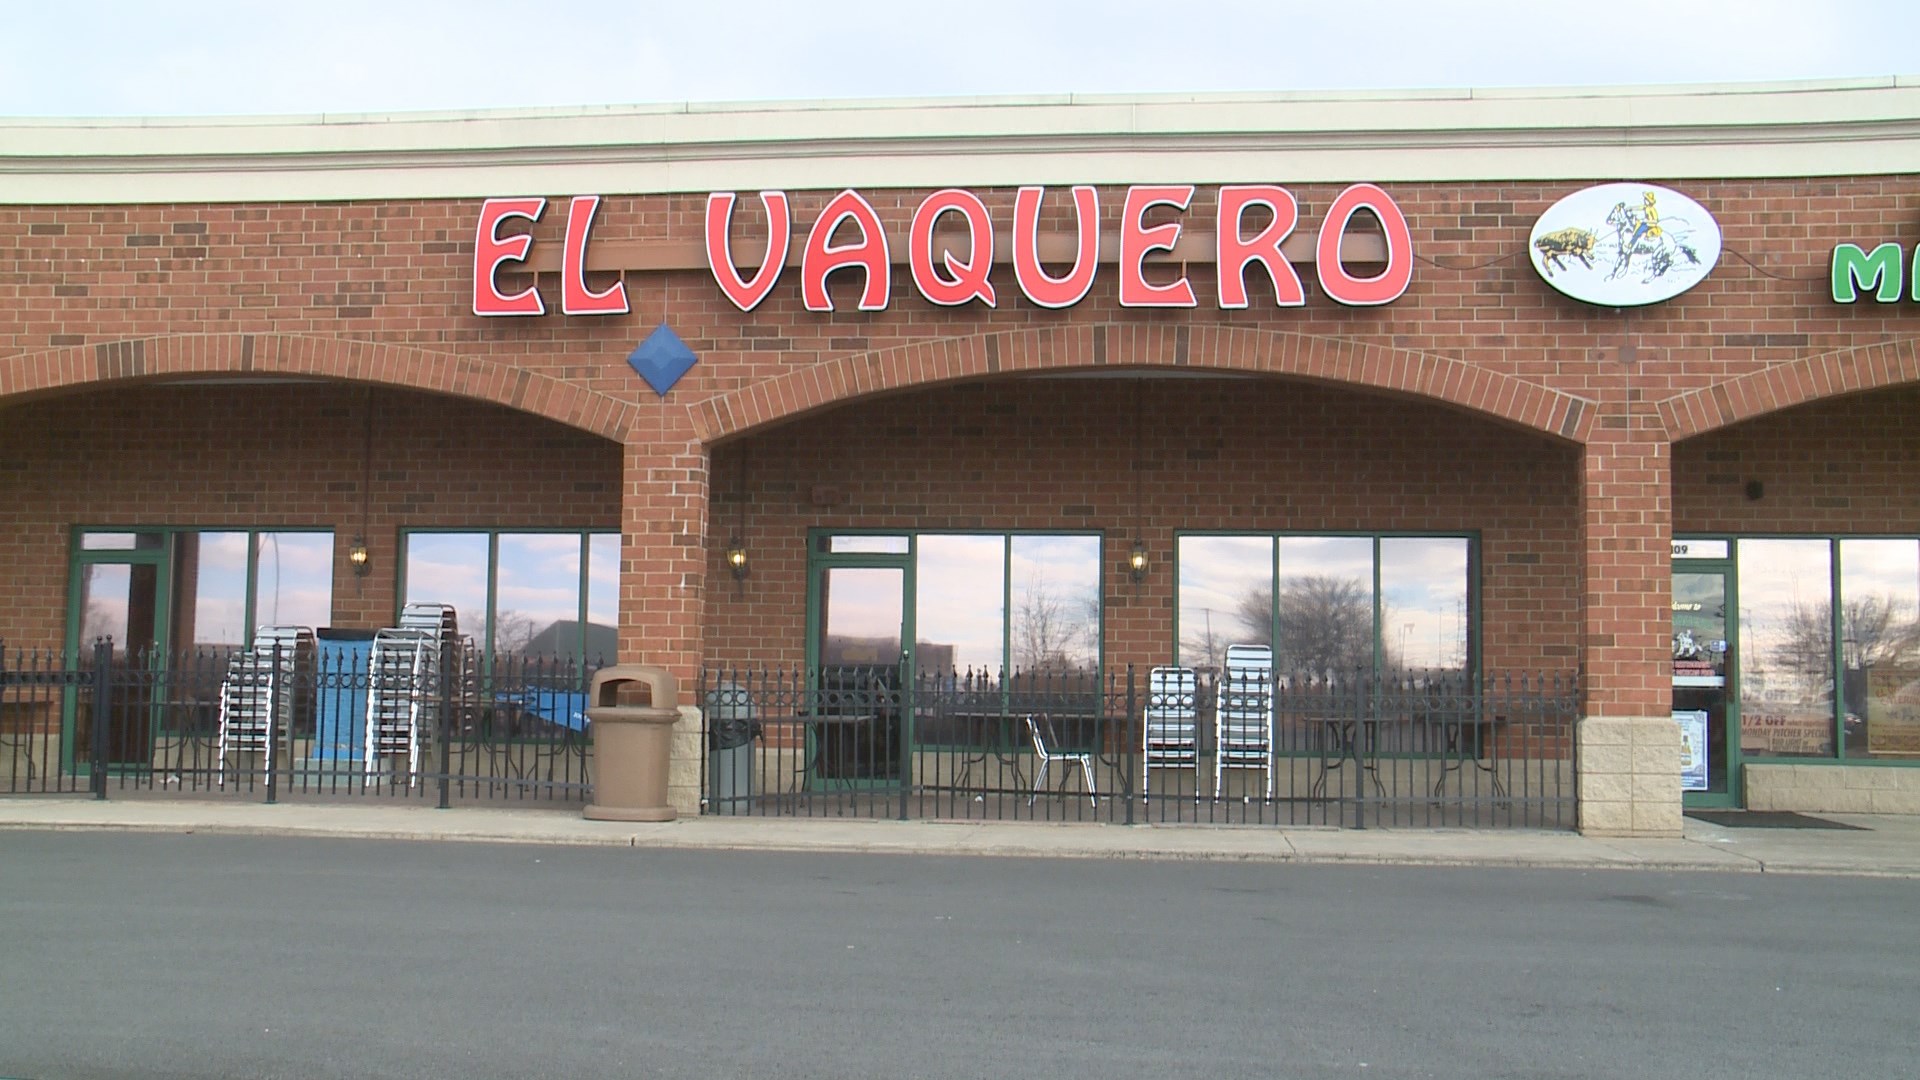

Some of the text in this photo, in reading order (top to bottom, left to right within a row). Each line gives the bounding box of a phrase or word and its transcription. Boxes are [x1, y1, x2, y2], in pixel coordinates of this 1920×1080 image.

[473, 183, 1413, 315] EL VAQUERO
[1832, 243, 1920, 303] M
[1742, 714, 1762, 727] 1/2
[1765, 715, 1786, 726] OFF
